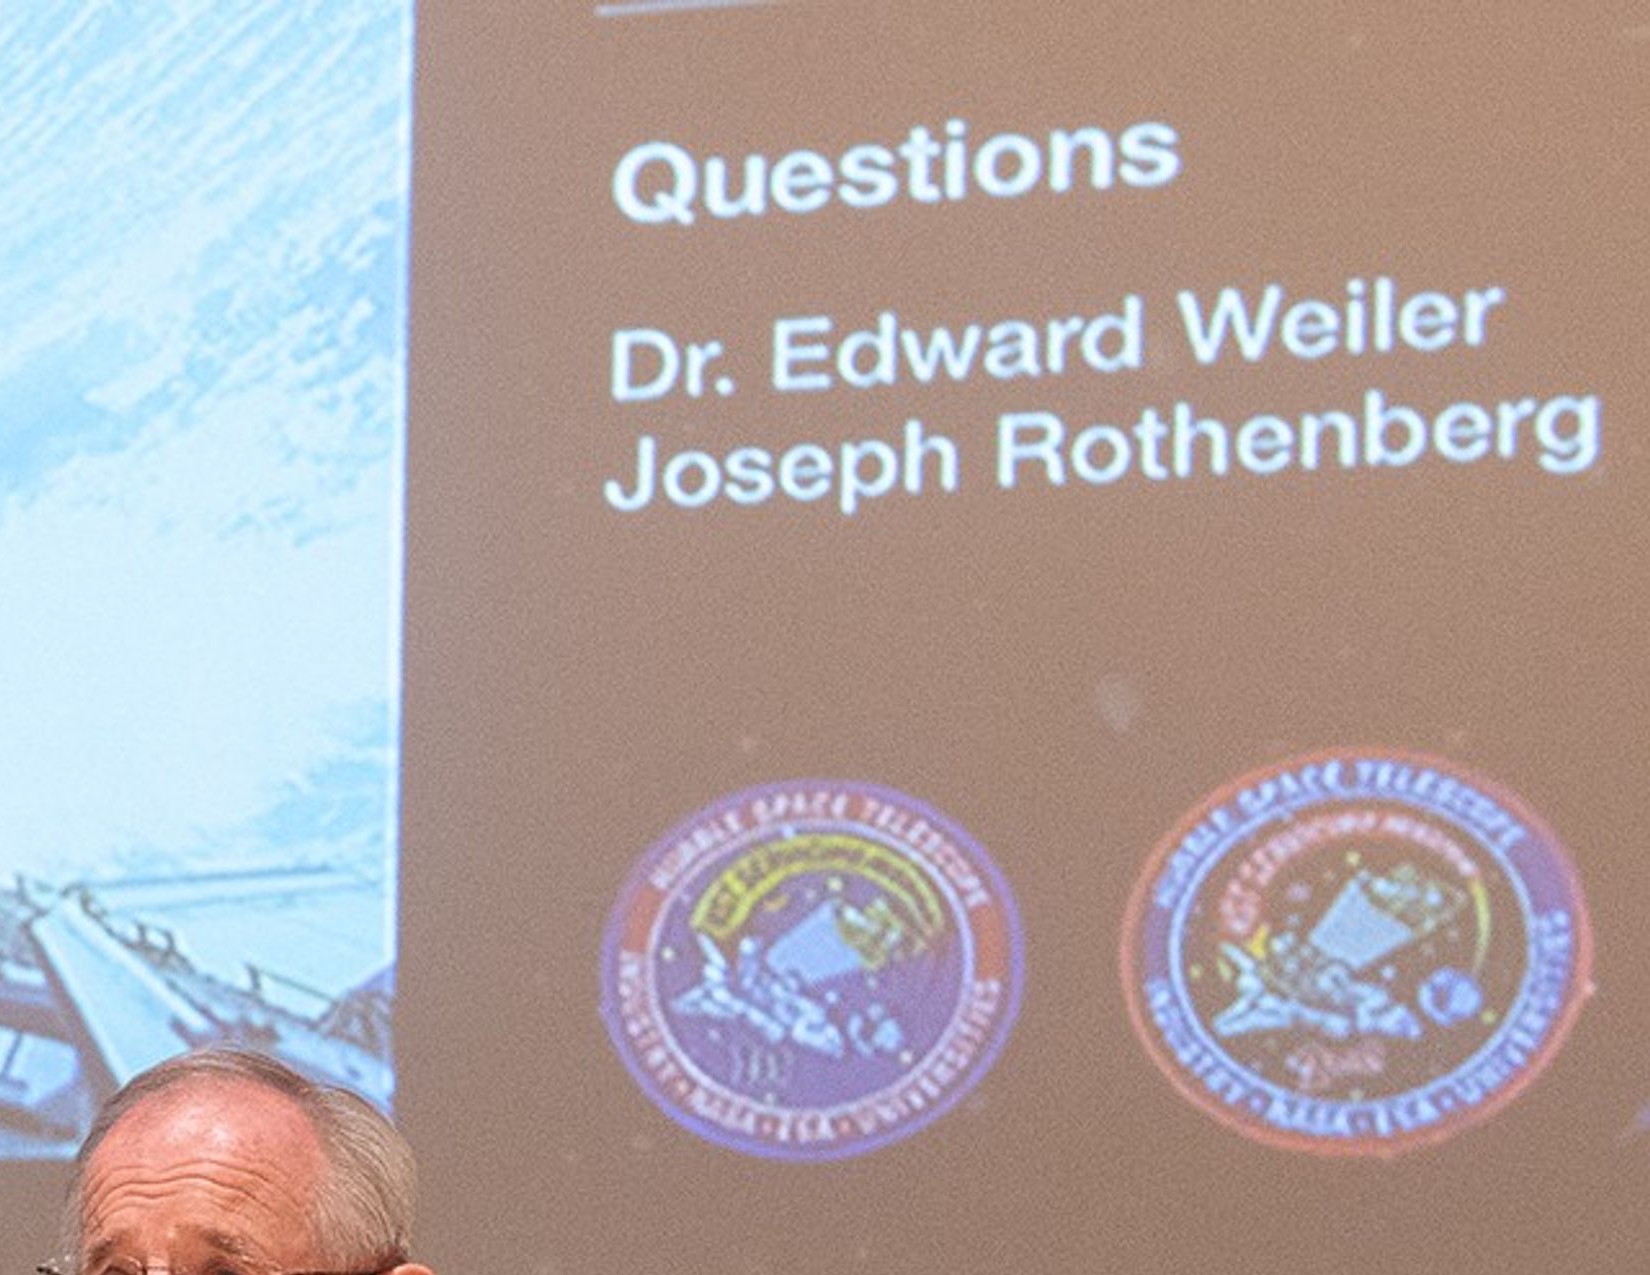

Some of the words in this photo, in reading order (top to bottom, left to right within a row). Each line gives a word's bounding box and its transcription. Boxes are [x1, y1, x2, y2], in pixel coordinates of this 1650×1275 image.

[611, 117, 1183, 227] Questions
[610, 327, 736, 404] Dr.
[771, 294, 1146, 393] Edward
[1176, 276, 1507, 366] Weiler
[603, 418, 961, 516] Joseph
[997, 388, 1603, 489] Rothenberg
